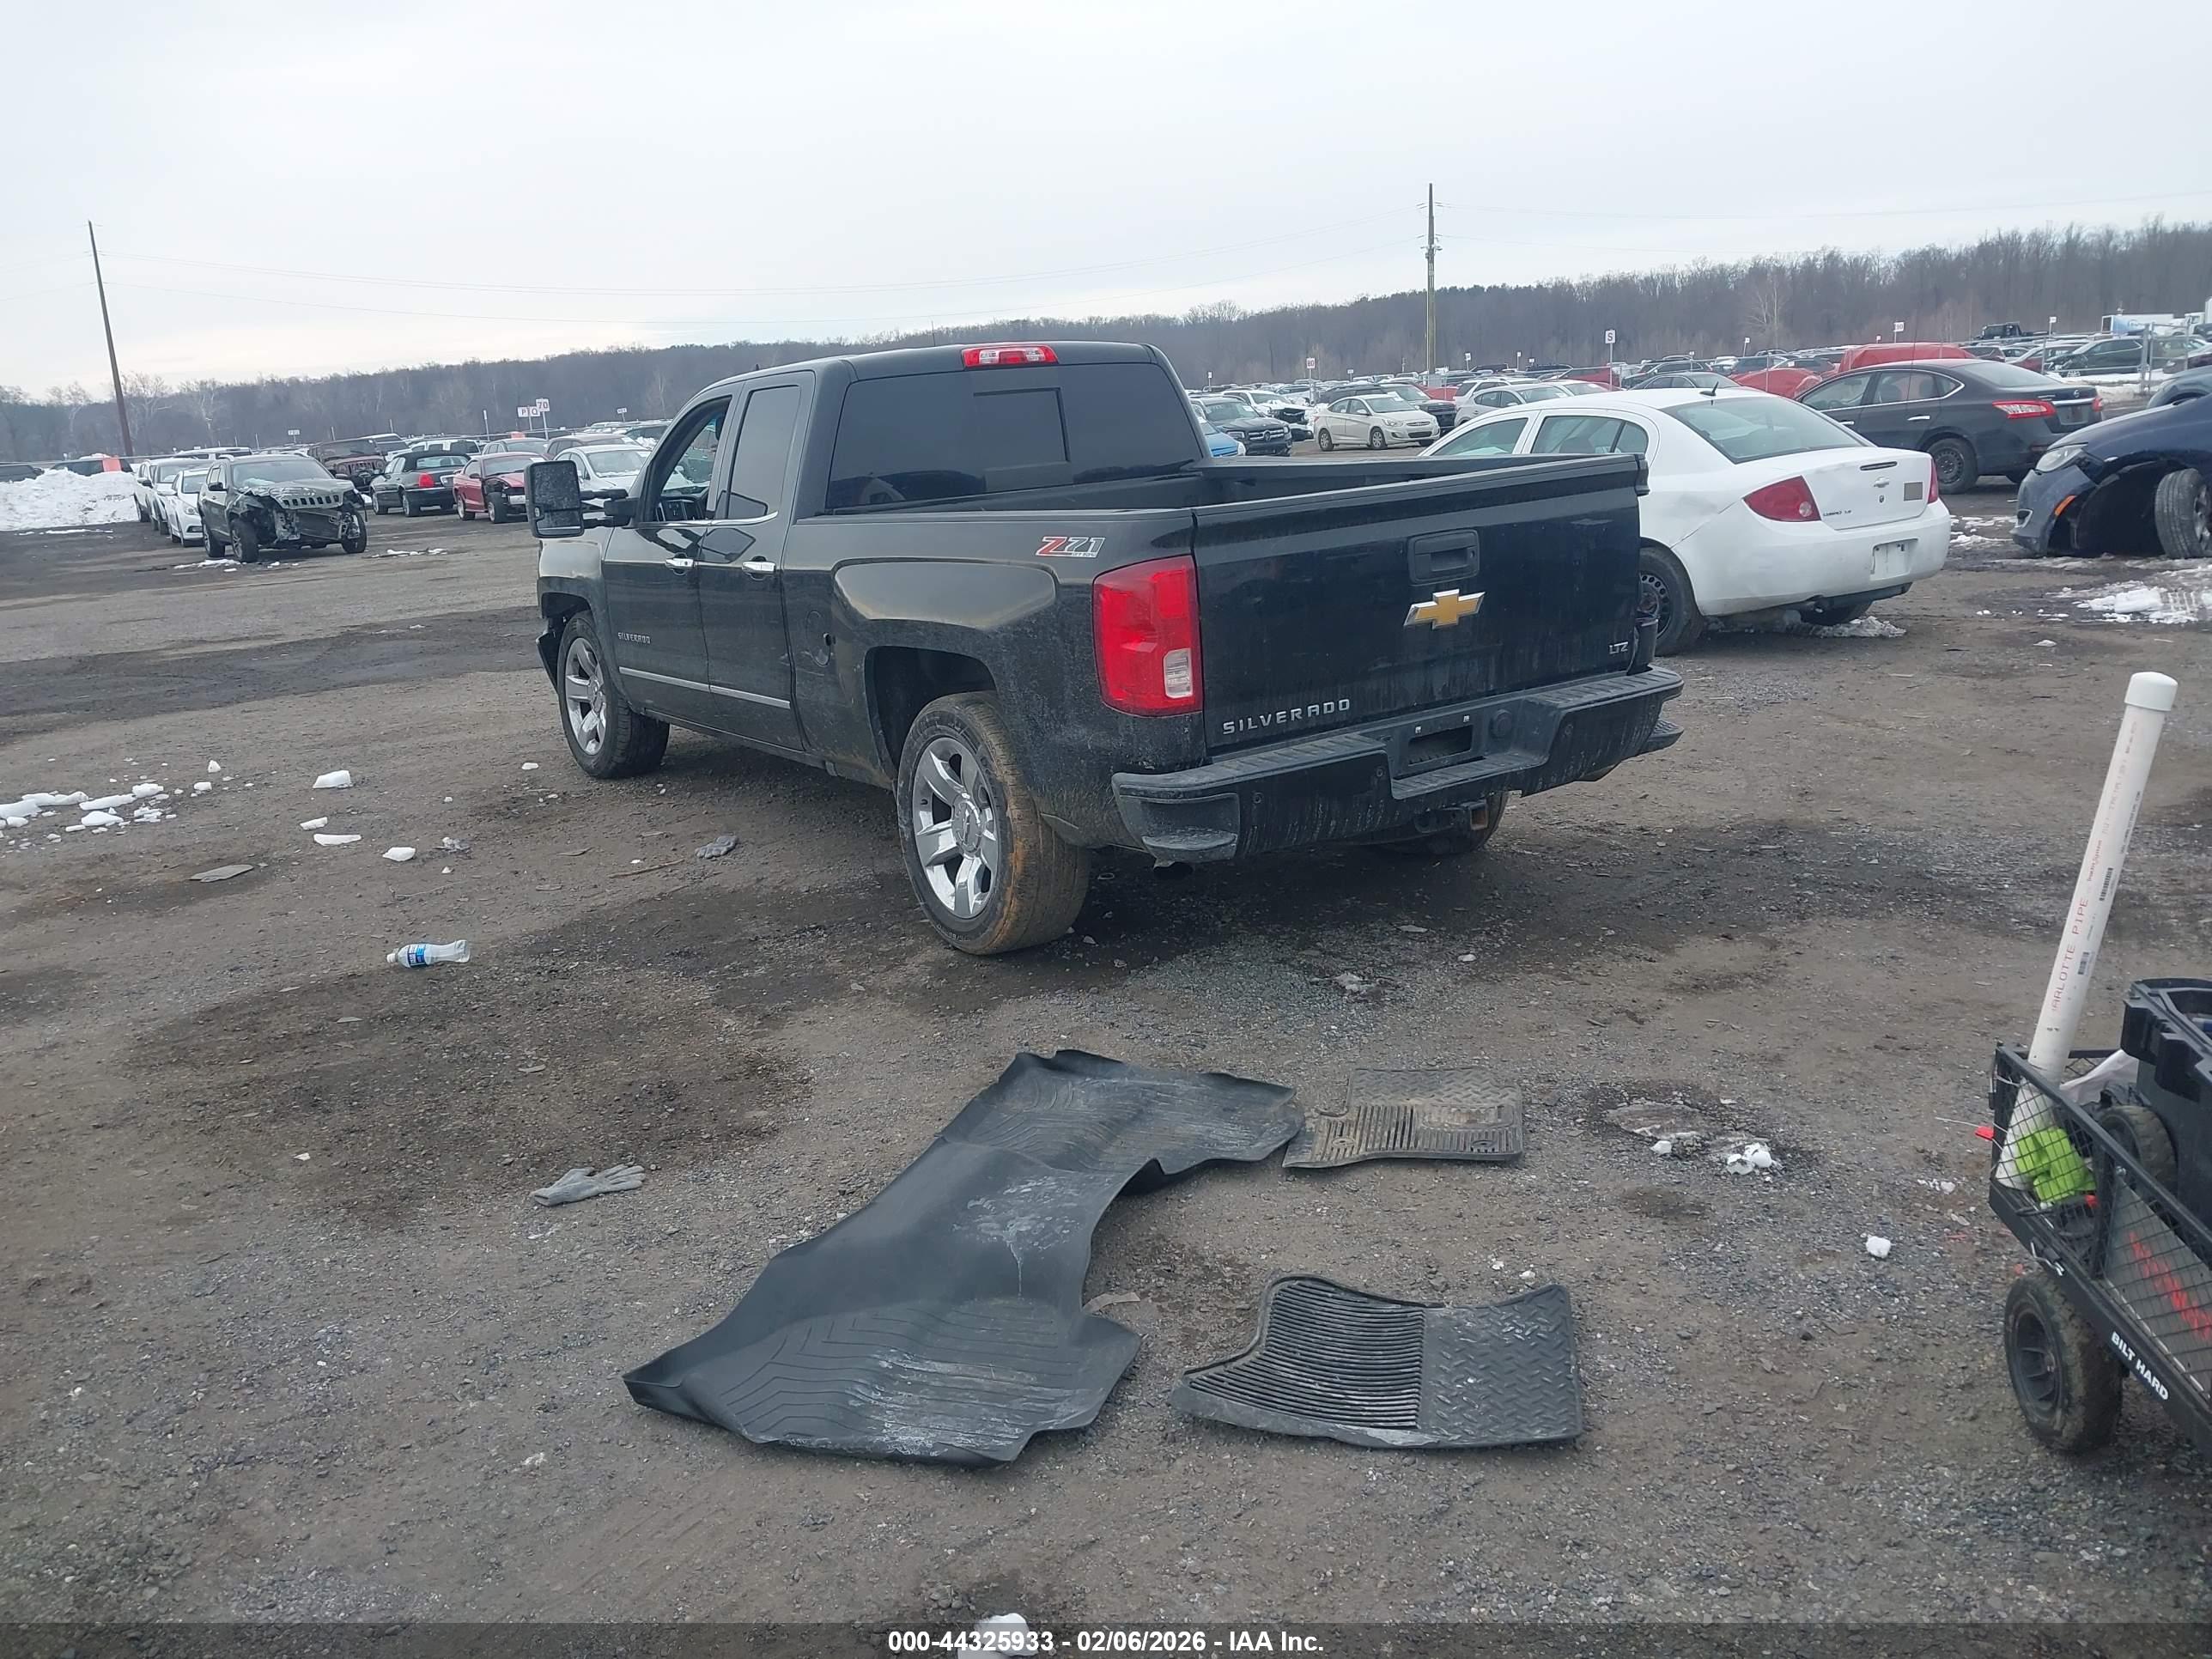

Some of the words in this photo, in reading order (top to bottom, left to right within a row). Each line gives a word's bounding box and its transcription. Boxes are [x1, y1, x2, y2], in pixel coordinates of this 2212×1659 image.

[1607, 332, 1613, 341] S
[1036, 536, 1106, 558] Z71
[617, 632, 651, 644] SILVERADO
[1609, 641, 1629, 655] LTZ
[1222, 698, 1351, 735] SILVERADO
[2071, 898, 2089, 936] PIPE
[2111, 1331, 2136, 1362] BILT
[2135, 1358, 2169, 1401] HARD
